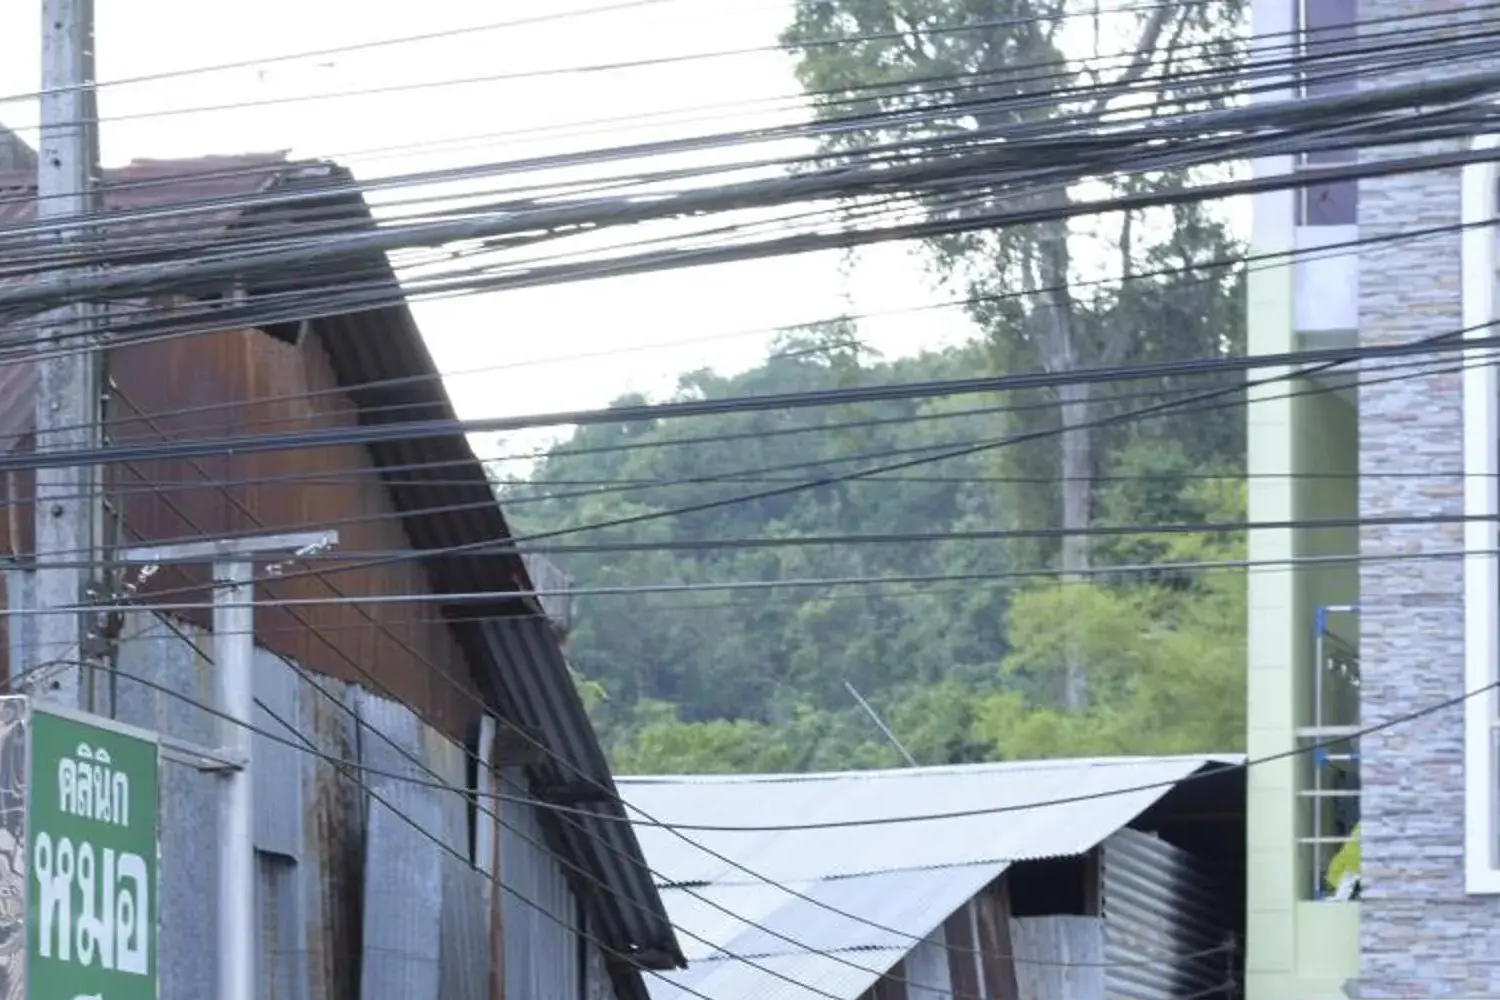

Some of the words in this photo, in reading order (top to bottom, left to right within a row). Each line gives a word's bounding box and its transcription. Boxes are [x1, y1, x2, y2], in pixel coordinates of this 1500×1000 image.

[58, 741, 129, 827] คลินิก
[34, 831, 148, 976] หมอ
